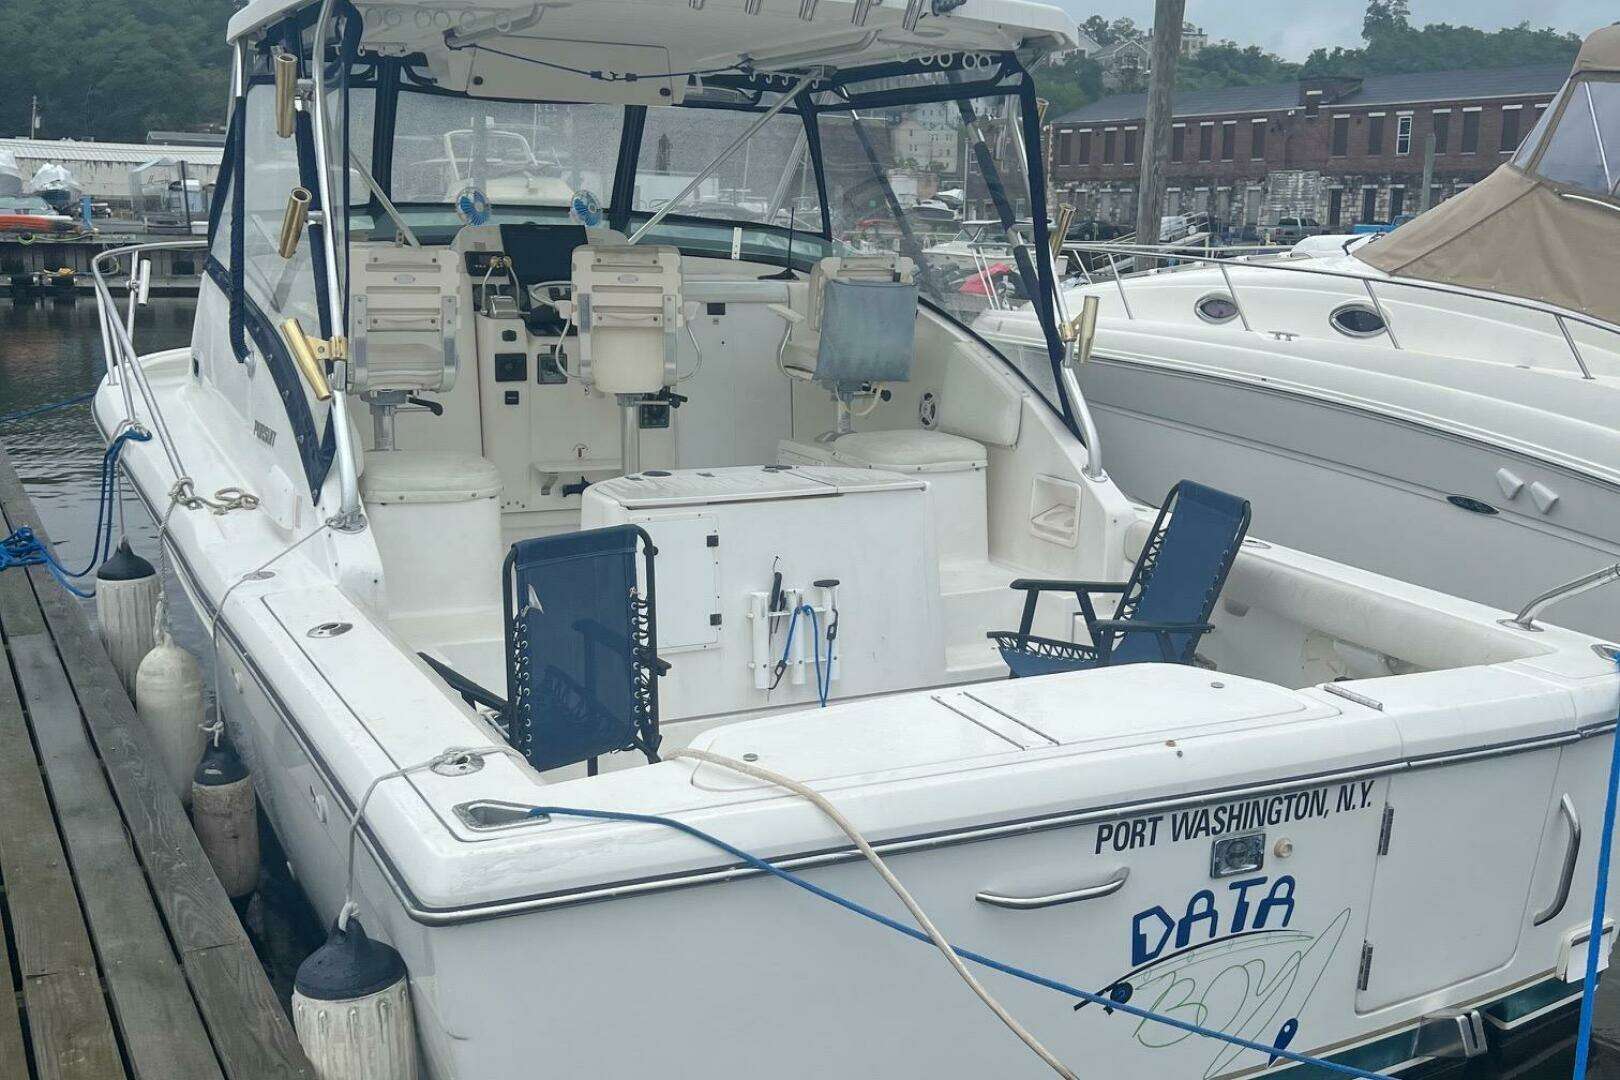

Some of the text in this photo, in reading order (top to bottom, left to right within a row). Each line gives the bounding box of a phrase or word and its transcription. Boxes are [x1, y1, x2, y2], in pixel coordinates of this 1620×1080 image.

[1095, 780, 1375, 855] PORT WASHINGTON, N.Y.
[1131, 875, 1297, 967] DATA
